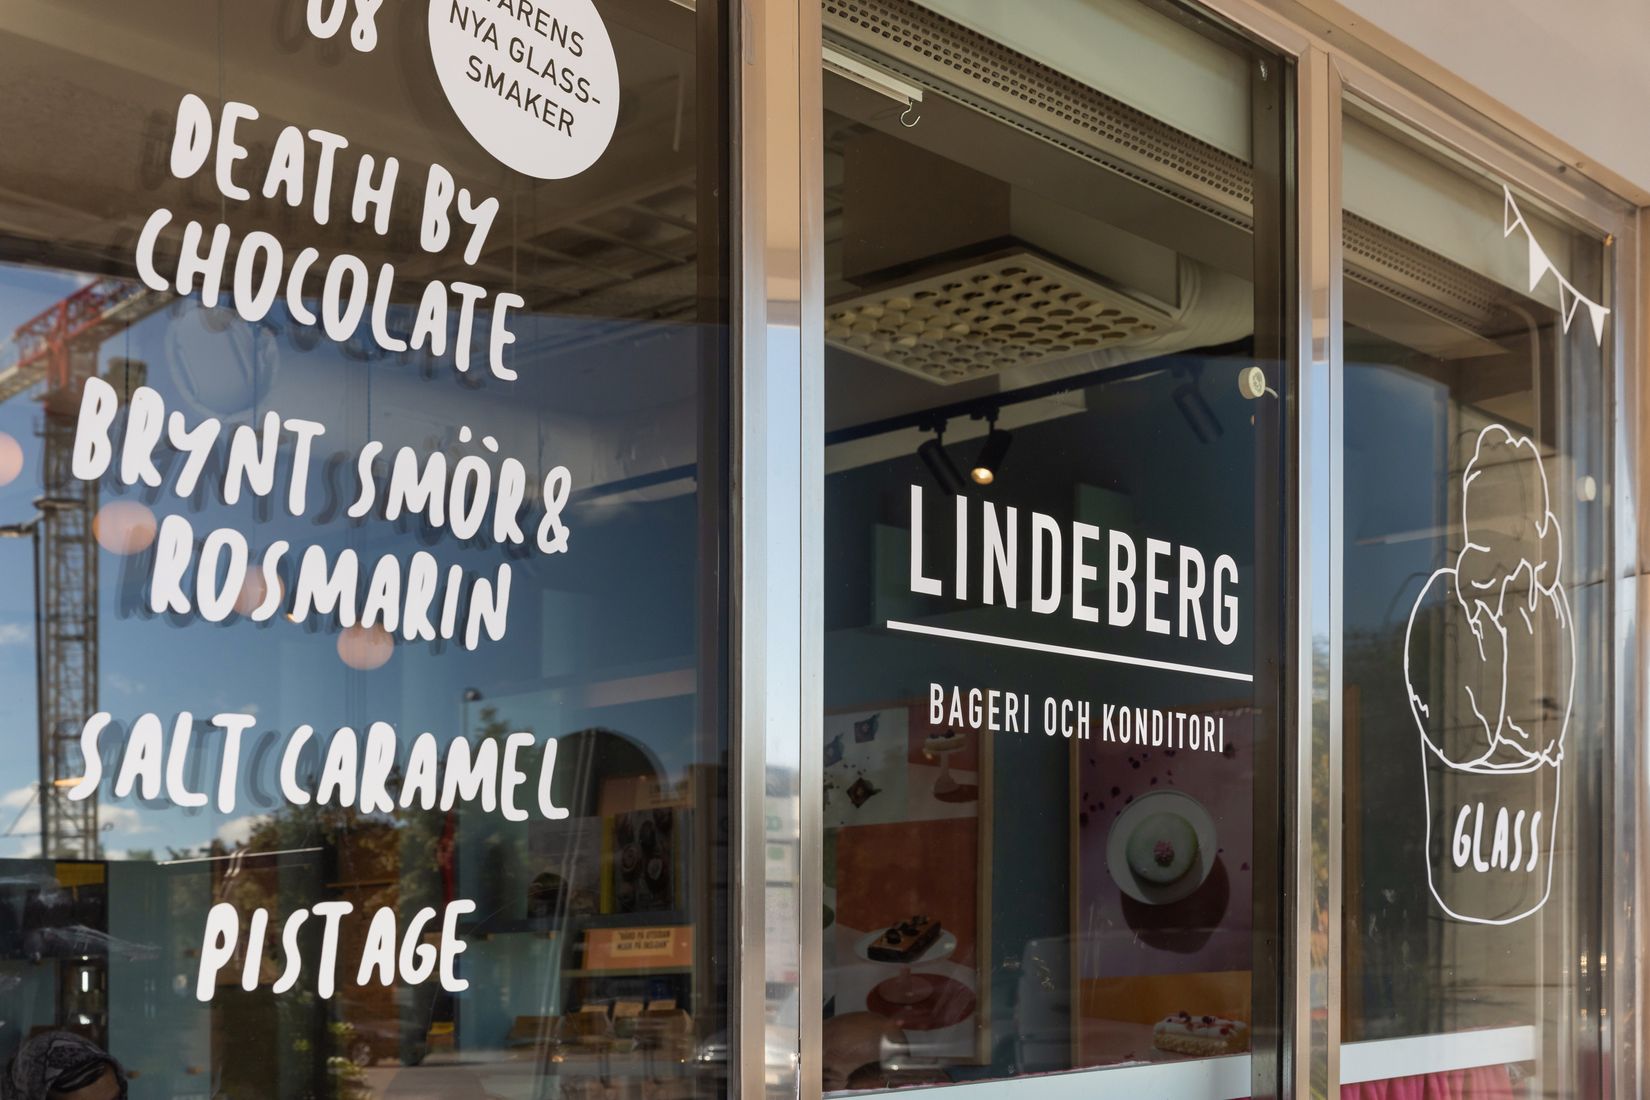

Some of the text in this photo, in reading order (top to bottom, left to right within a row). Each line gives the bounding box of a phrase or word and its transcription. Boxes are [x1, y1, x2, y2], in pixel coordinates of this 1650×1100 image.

[449, 0, 601, 104] NYA GLASS-
[487, 0, 584, 57] RENS
[466, 55, 575, 138] SMAKER
[170, 93, 499, 265] DEATH BY
[136, 208, 525, 381] CHOCOLATE
[72, 376, 572, 554] BRYNT SMÖR &
[150, 514, 512, 651] ROSMARIN
[910, 484, 1239, 645] LINDEBERG
[67, 711, 570, 822] SALT CARAMEL
[930, 683, 1224, 753] BAGERI OCH KONDITORI
[1452, 802, 1542, 873] GLASS
[196, 899, 476, 1002] PISTAGE
